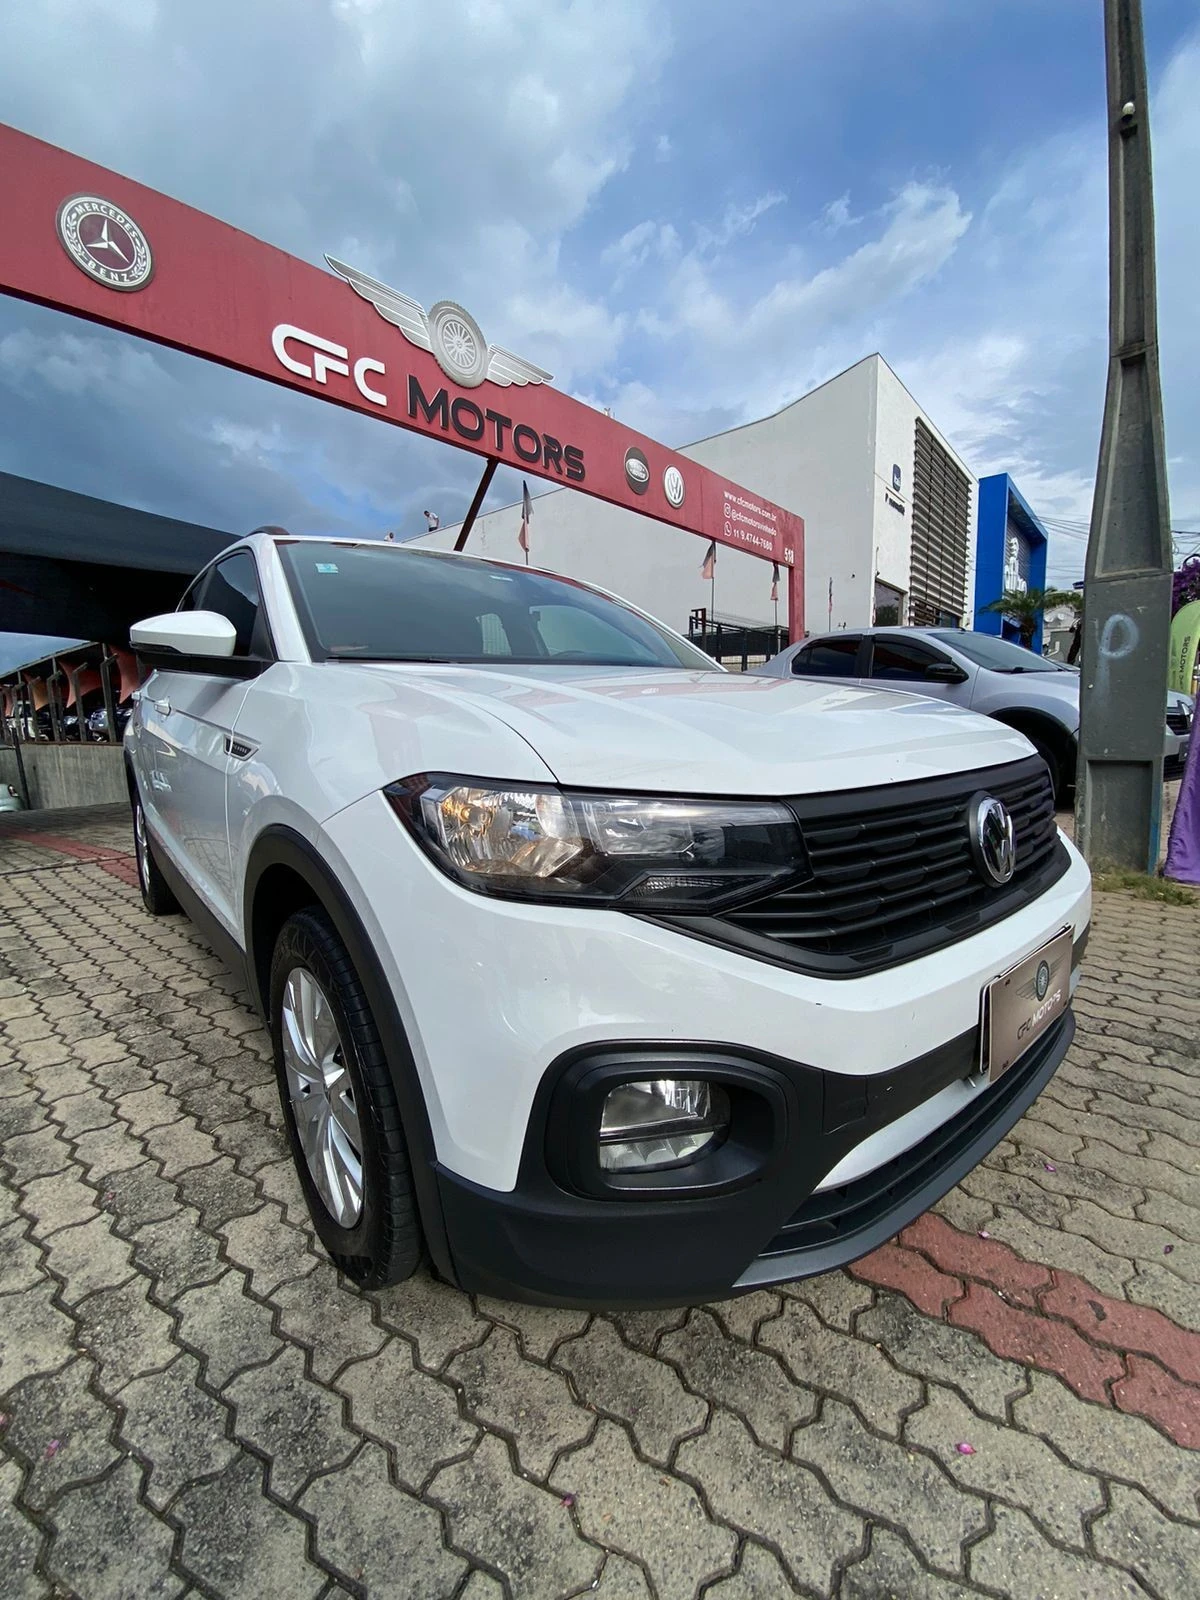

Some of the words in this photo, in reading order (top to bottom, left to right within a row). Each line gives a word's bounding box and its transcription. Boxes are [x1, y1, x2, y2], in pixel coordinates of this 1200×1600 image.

[74, 202, 138, 238] MERCEDES
[87, 259, 130, 282] BENZ
[271, 323, 387, 407] CFC
[406, 373, 586, 482] MOTORS
[1180, 635, 1191, 674] MOTORS
